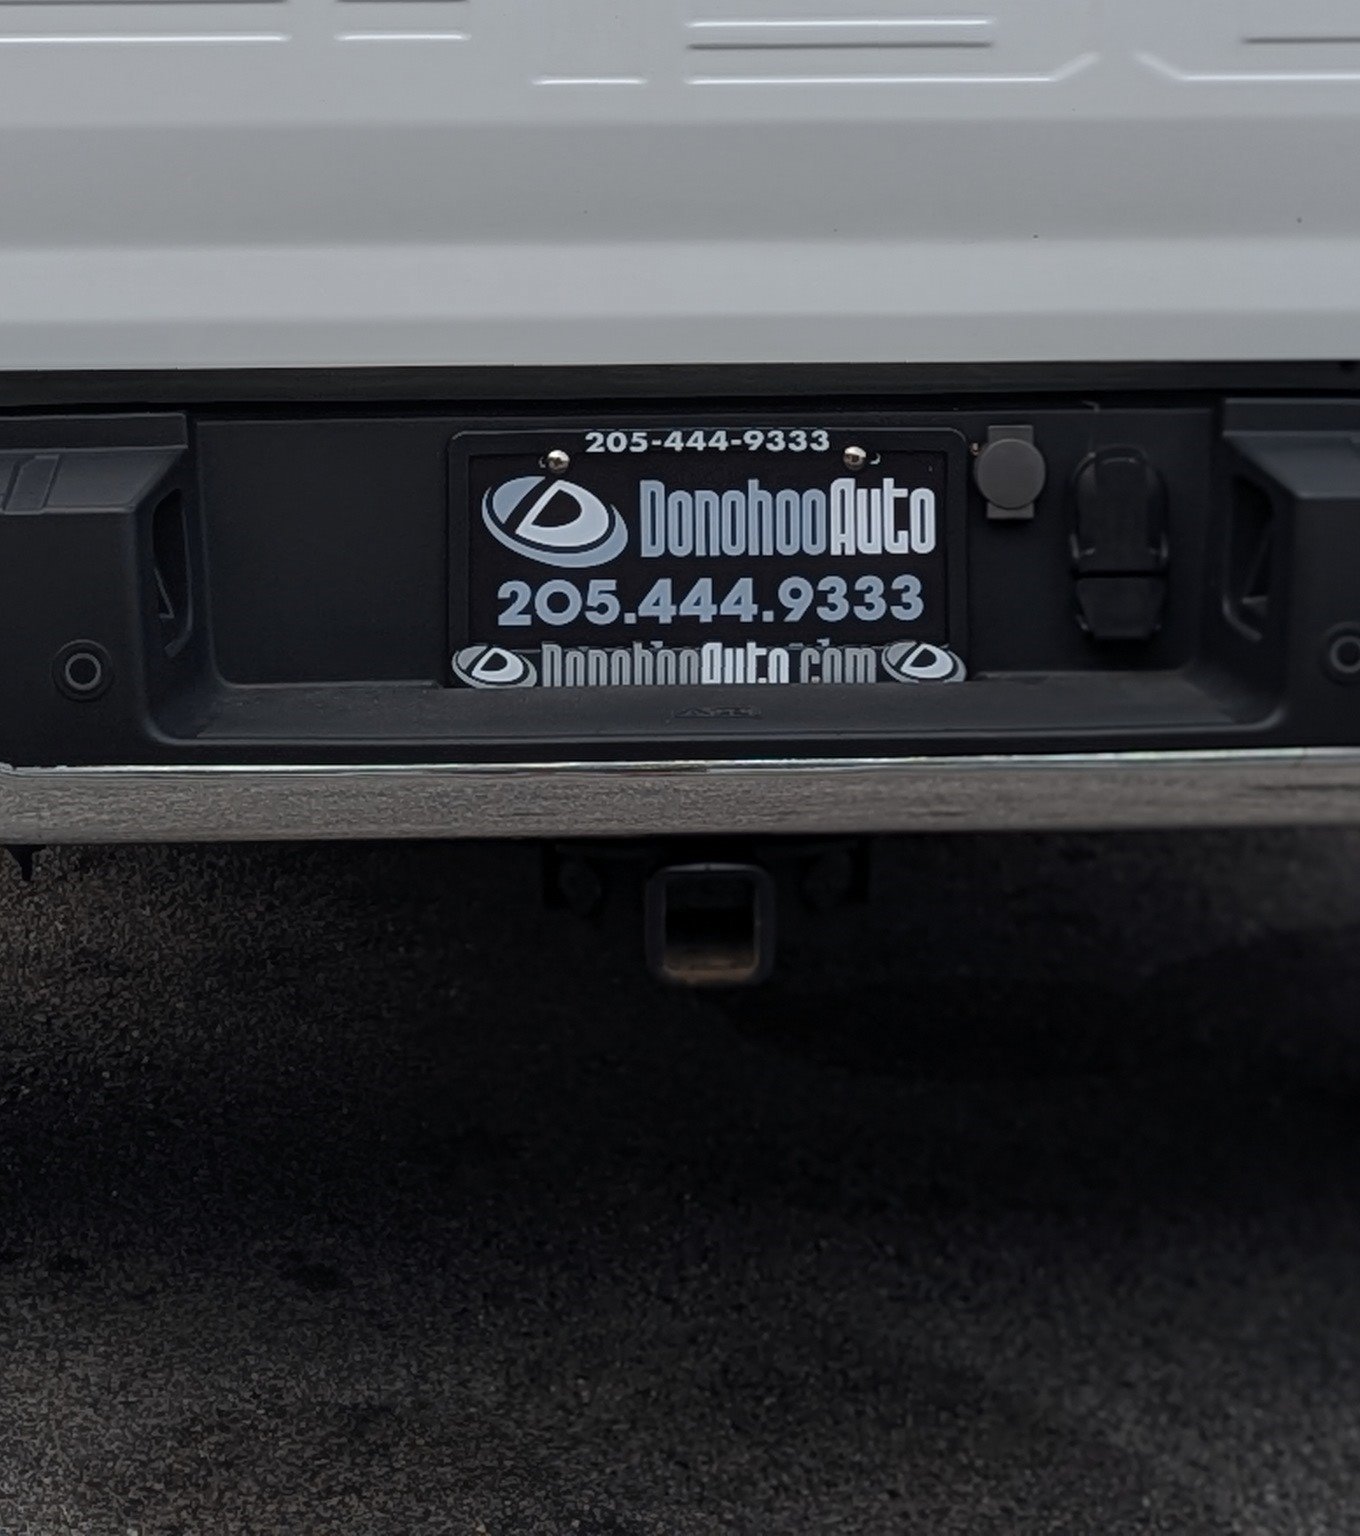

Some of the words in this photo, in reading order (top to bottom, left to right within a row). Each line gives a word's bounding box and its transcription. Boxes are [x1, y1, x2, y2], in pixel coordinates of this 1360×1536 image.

[585, 430, 830, 453] 205-444-9333
[640, 477, 937, 557] DonohooAuto
[497, 575, 924, 625] 205.444.9333
